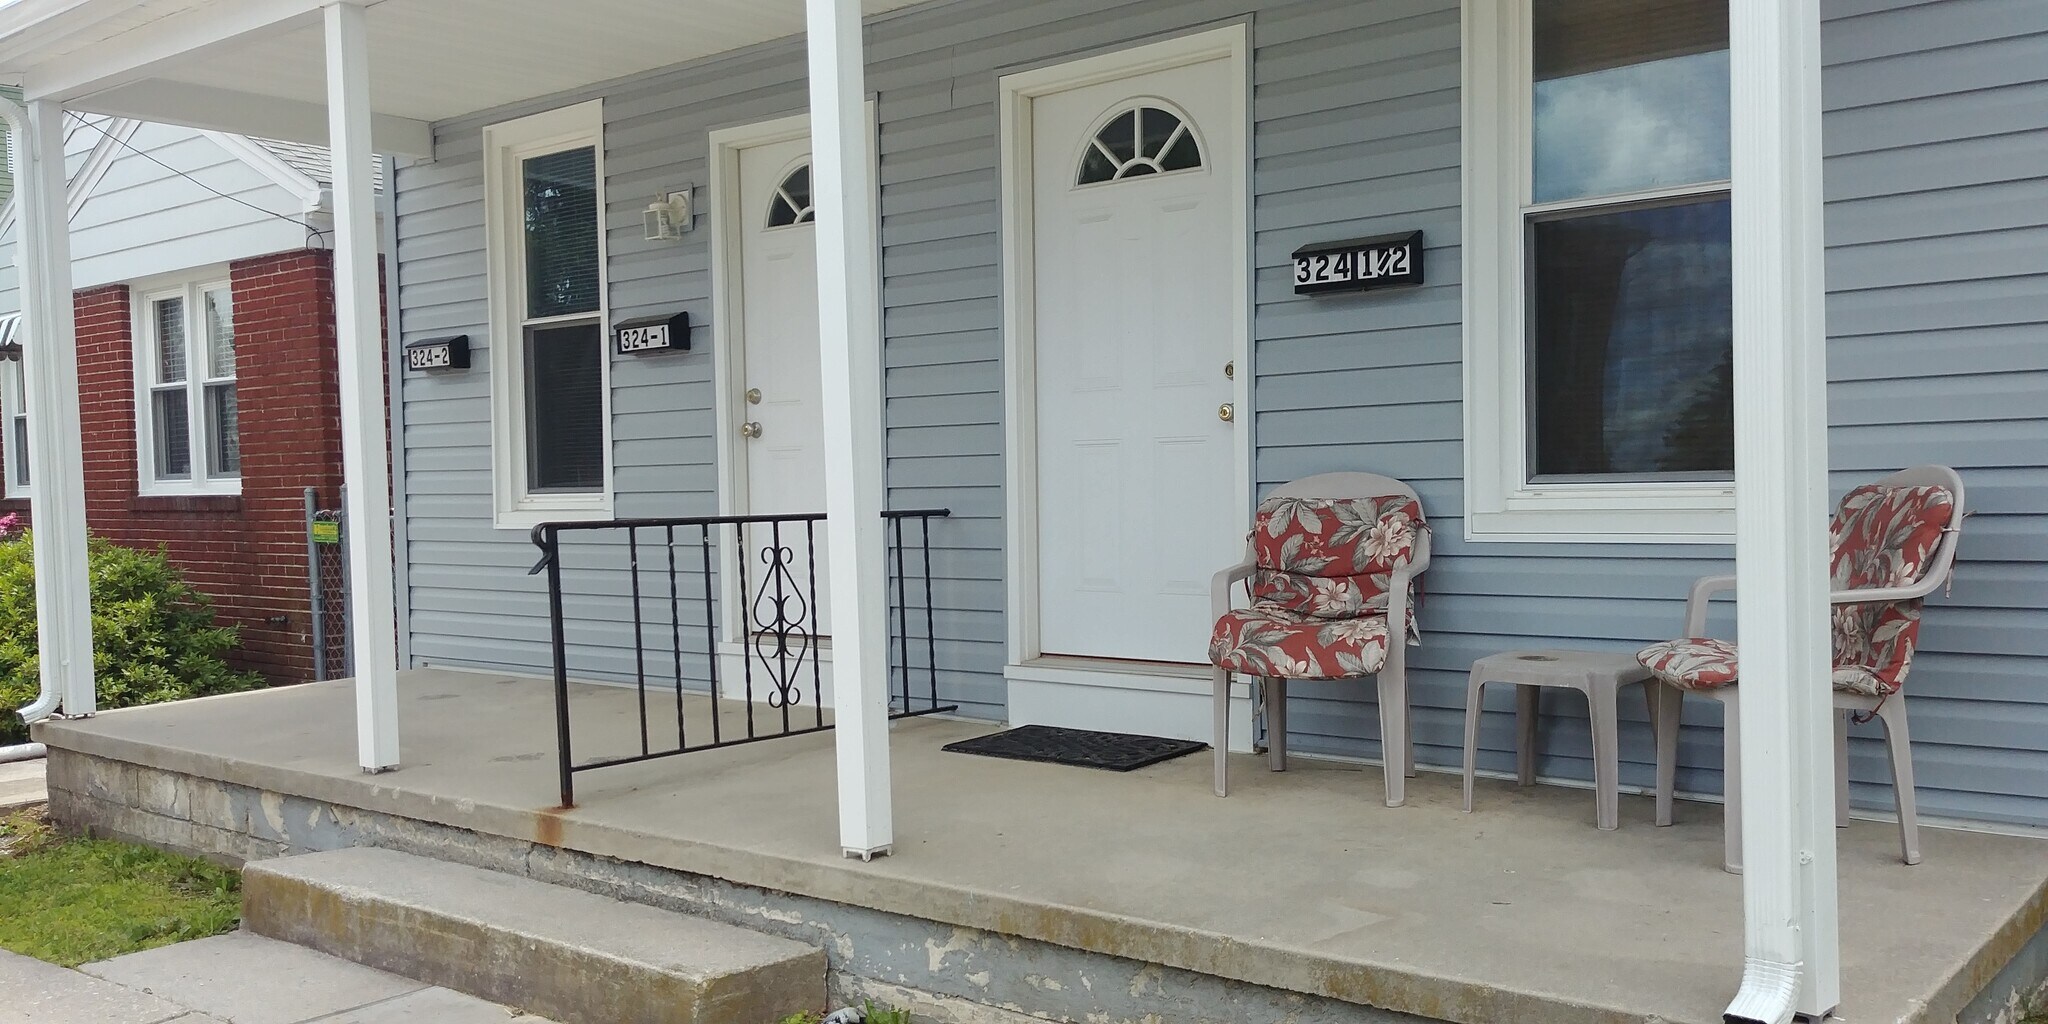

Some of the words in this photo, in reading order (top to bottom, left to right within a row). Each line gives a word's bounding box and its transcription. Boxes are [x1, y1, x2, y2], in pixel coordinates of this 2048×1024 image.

[1297, 251, 1350, 283] 324
[623, 326, 667, 349] 324-1
[412, 347, 448, 366] 324-2
